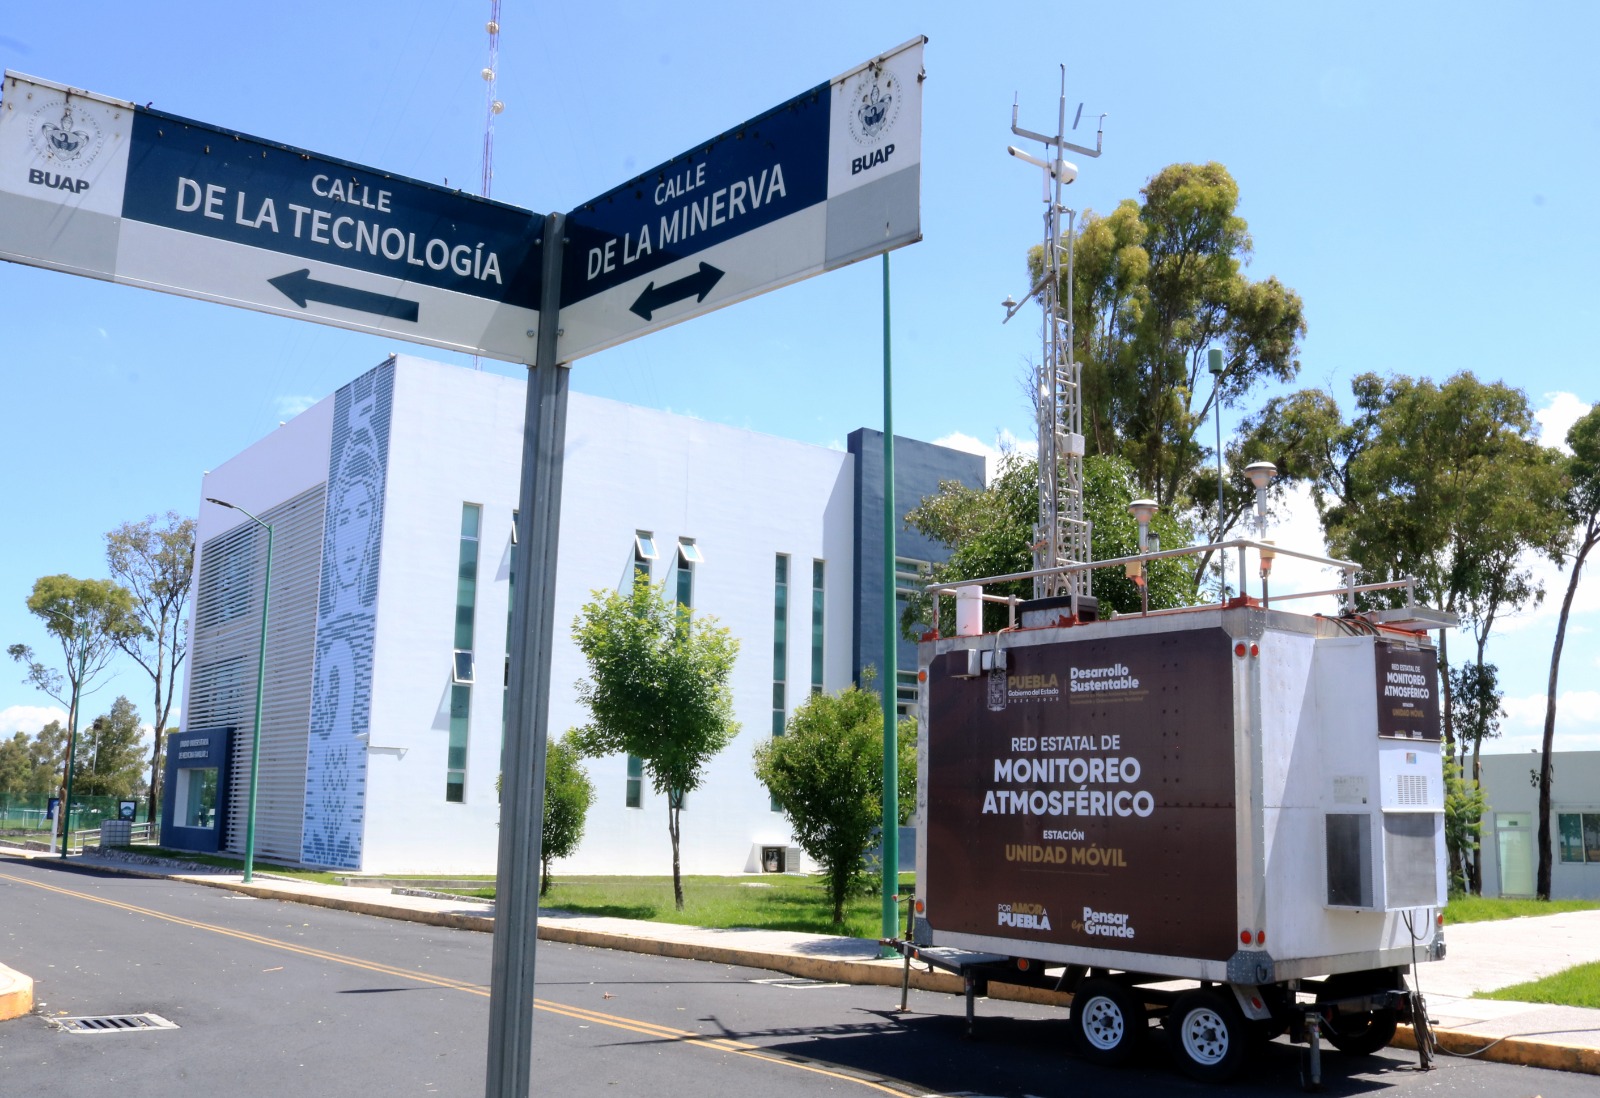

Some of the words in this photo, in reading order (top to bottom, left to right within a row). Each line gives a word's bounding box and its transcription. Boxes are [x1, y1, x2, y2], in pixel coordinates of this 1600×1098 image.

[852, 143, 895, 175] BUAP
[28, 168, 90, 194] BUAP
[654, 162, 706, 206] CALLE
[311, 173, 392, 213] CALLE
[175, 176, 225, 221] DE
[235, 191, 280, 233] LA
[288, 203, 504, 285] TECNOLOGÍA
[586, 238, 617, 281] DE
[622, 223, 652, 266] LA
[658, 163, 787, 250] MINERVA
[1070, 664, 1129, 679] Desarrollo
[1387, 672, 1425, 685] MONITOREO
[1008, 674, 1058, 689] PUEBLA
[1070, 676, 1139, 692] Sustentable
[1008, 689, 1031, 697] Gobierno
[1032, 688, 1040, 696] del
[1384, 685, 1429, 699] ATMOSFÉRICO
[1011, 738, 1037, 751] RED
[1041, 736, 1098, 751] ESTATAL
[1101, 735, 1121, 750] DE
[994, 757, 1141, 783] MONITOREO
[982, 785, 1154, 817] ATMOSFÉRICO
[1043, 829, 1085, 840] ESTACIÓN
[1005, 844, 1067, 864] UNIDAD
[1071, 843, 1127, 867] MÓVIL
[998, 903, 1012, 912] POR
[1083, 906, 1129, 925] Pensar
[998, 911, 1051, 931] PUEBLA
[1071, 920, 1085, 933] en
[1084, 920, 1135, 939] Grande
